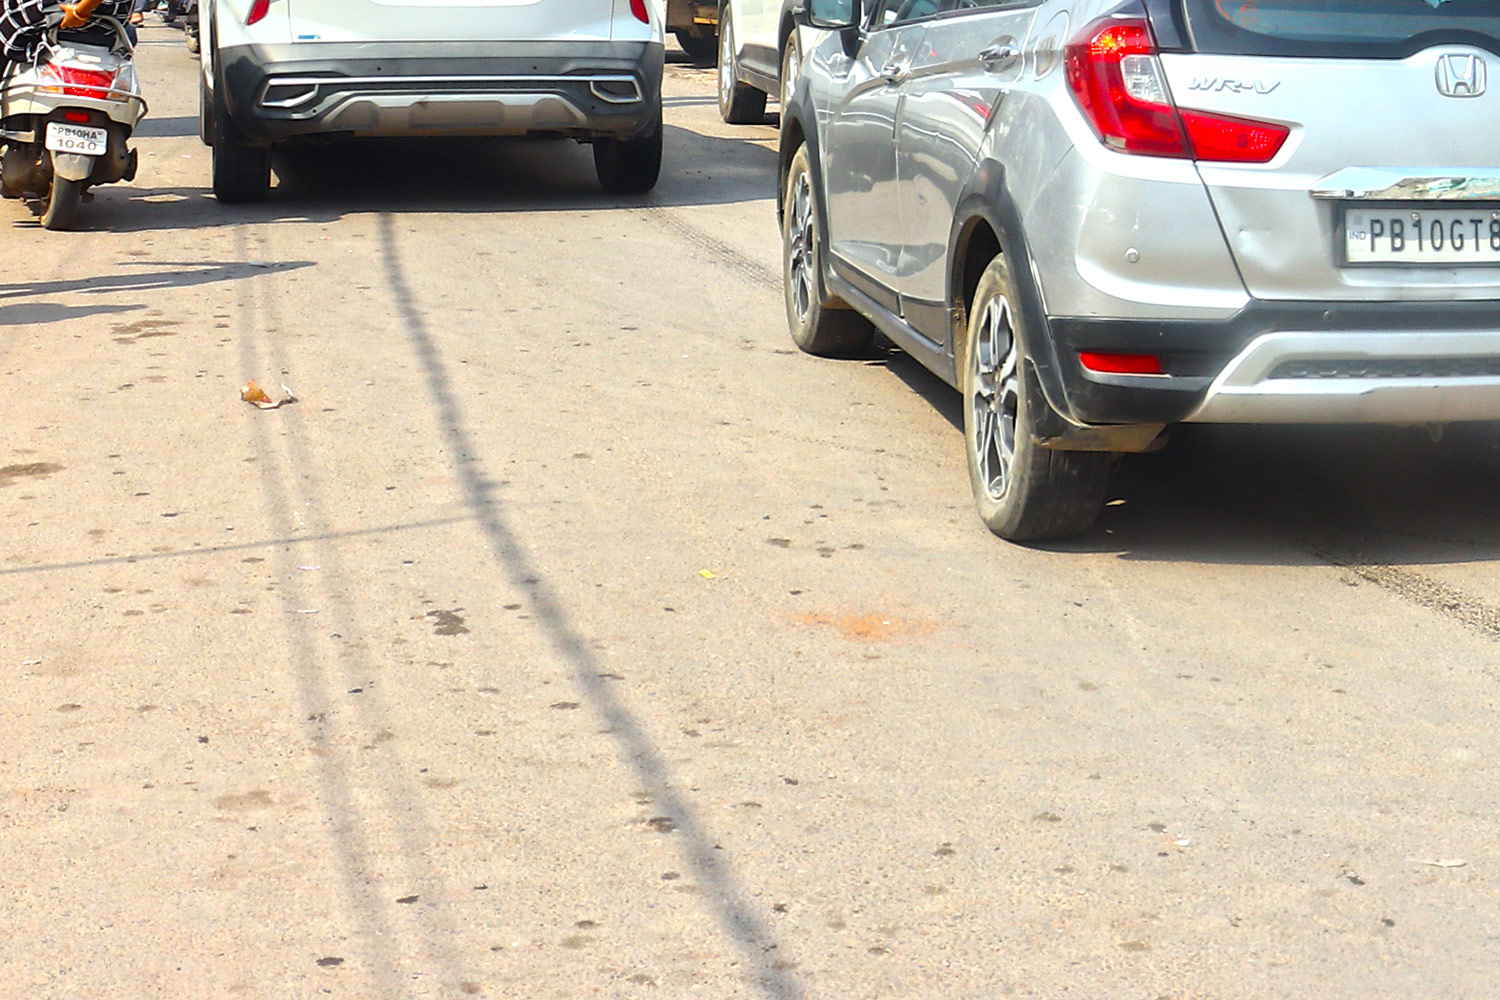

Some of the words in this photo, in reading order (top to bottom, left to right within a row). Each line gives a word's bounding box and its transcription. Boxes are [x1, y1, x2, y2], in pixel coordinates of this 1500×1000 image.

[1187, 76, 1281, 95] WR-V
[57, 126, 97, 139] PB10HA
[57, 138, 97, 151] 1040
